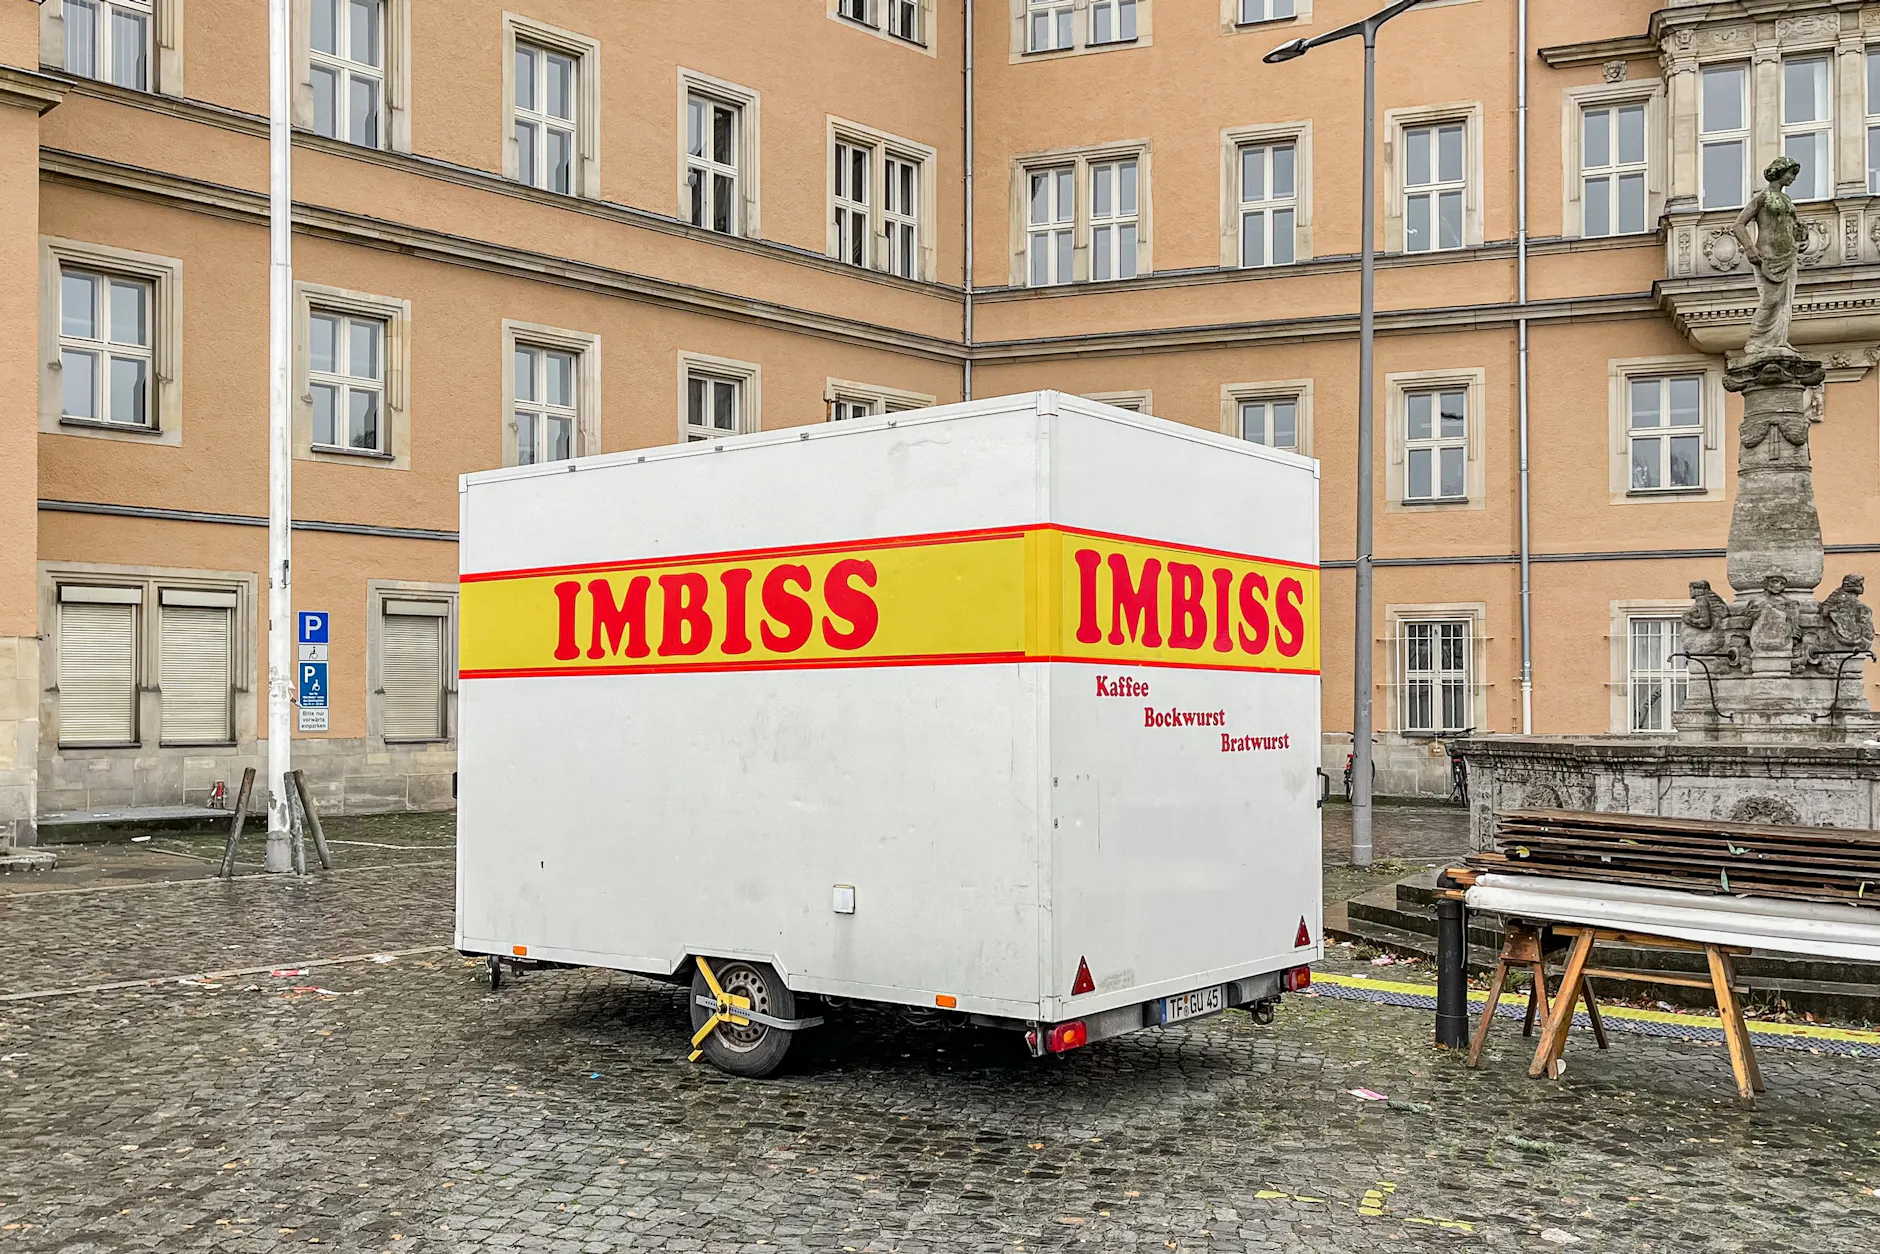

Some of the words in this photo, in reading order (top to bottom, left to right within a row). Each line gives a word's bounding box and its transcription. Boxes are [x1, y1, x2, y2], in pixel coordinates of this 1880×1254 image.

[553, 558, 879, 660] IMBISS
[1074, 548, 1304, 657] IMBISS
[305, 615, 322, 639] P
[304, 665, 316, 683] P
[1095, 675, 1150, 697] Kaffee
[1144, 707, 1226, 727] Bockwurst
[1221, 733, 1290, 752] Bratwurst
[1170, 998, 1183, 1018] TF
[1190, 992, 1203, 1014] GU
[1206, 988, 1219, 1009] 45
